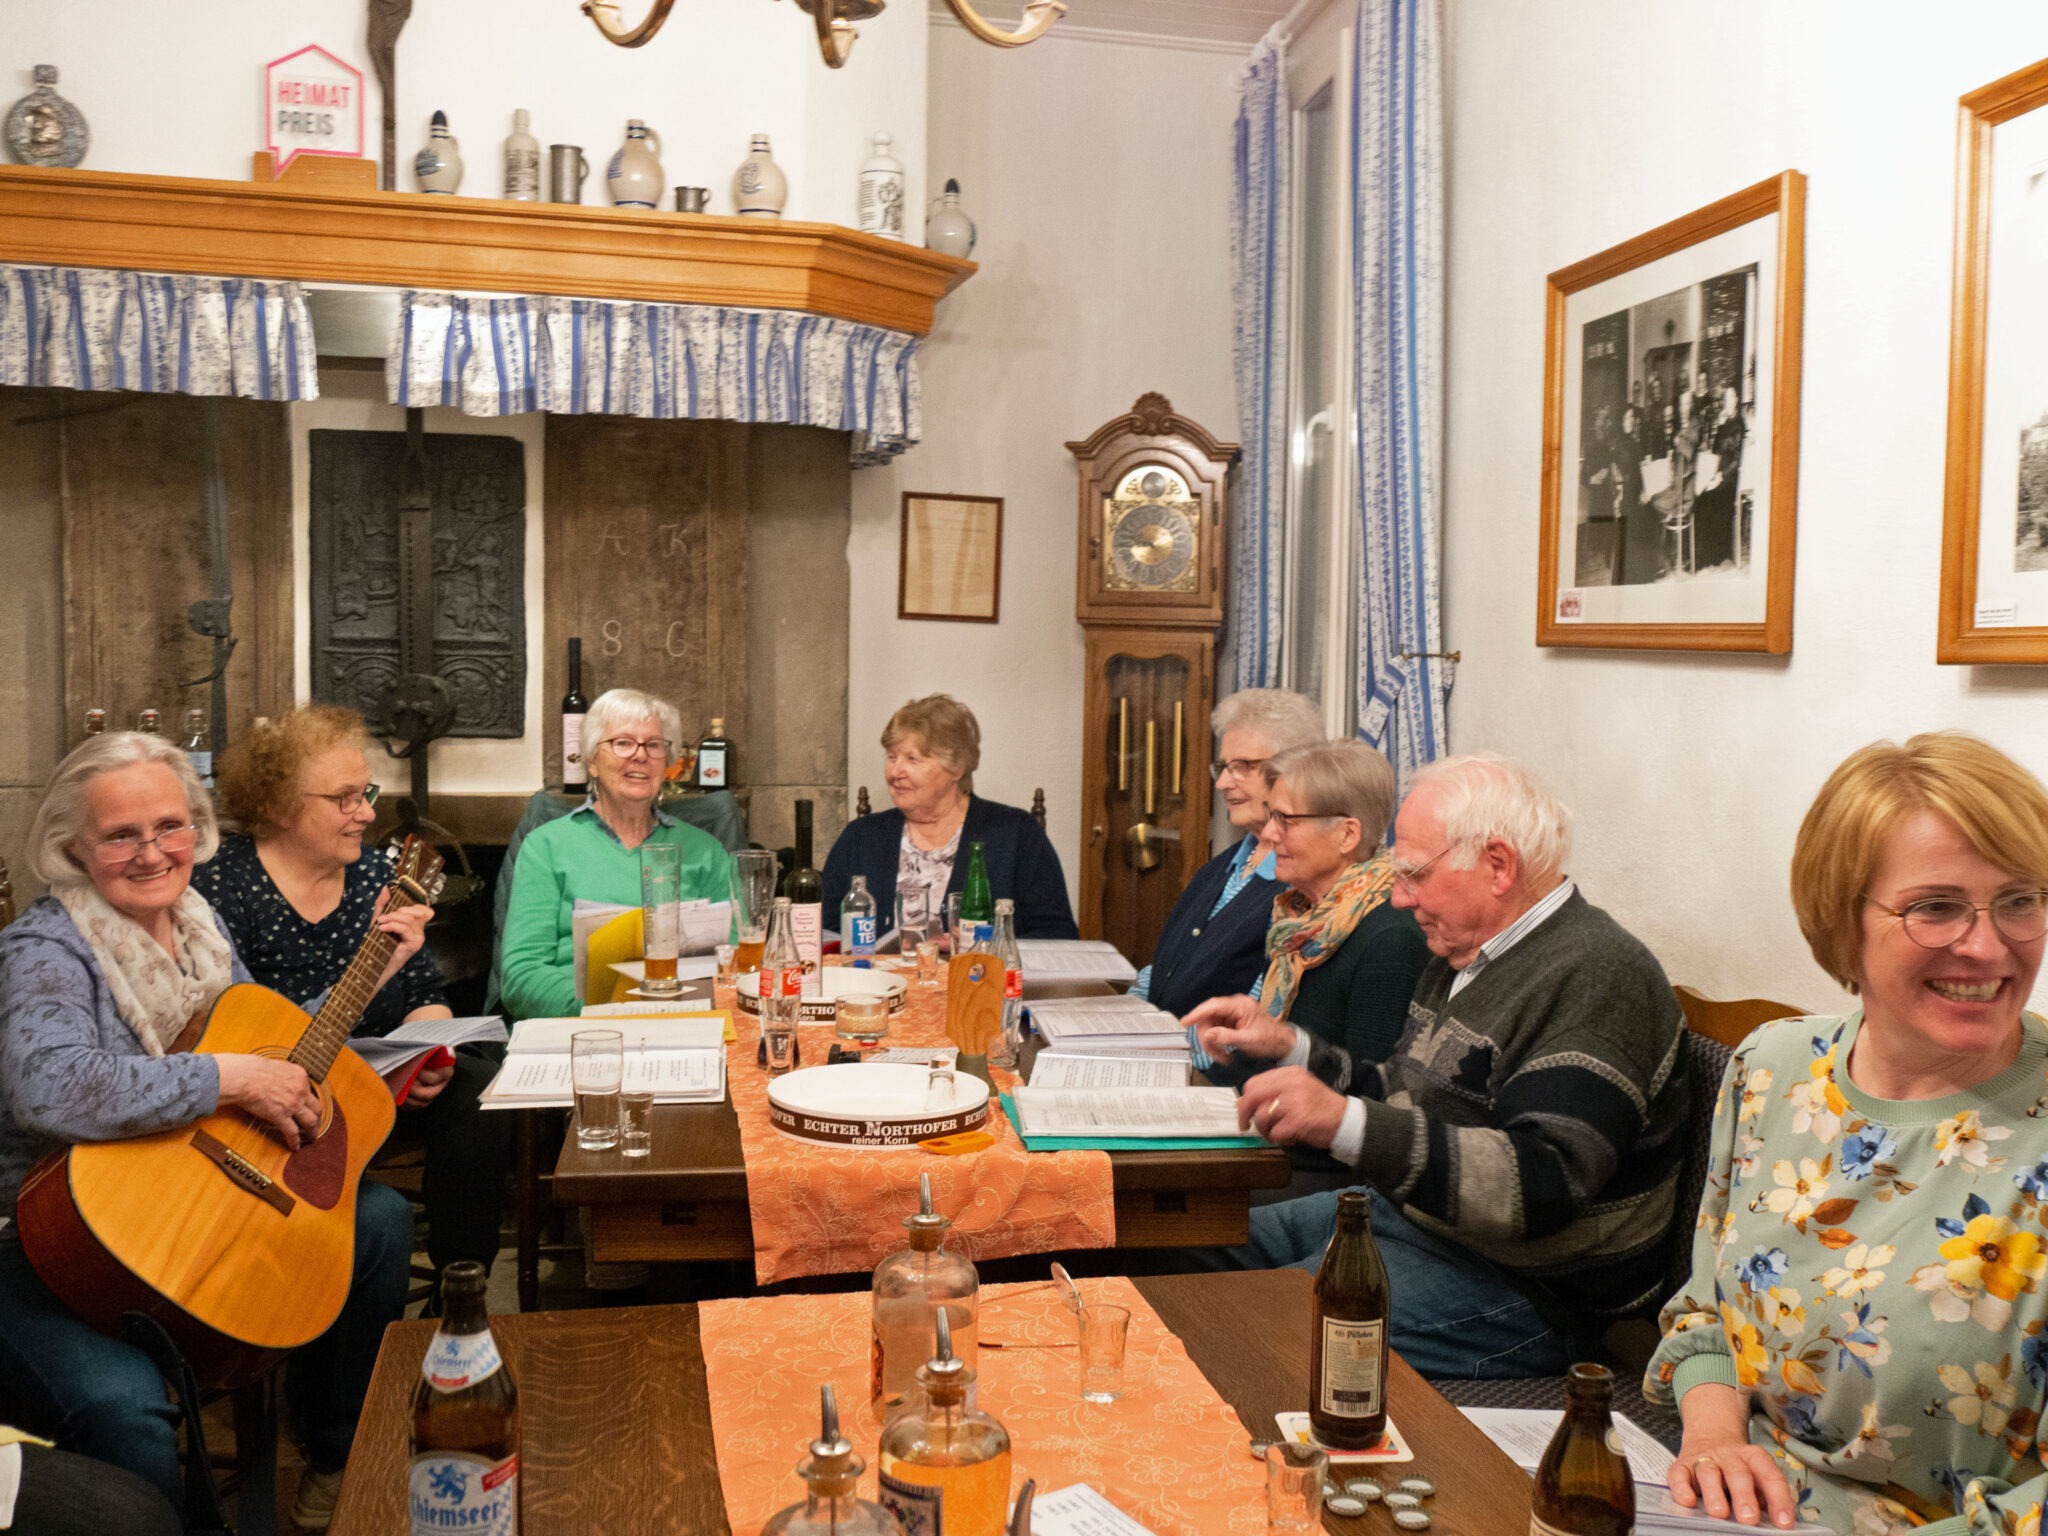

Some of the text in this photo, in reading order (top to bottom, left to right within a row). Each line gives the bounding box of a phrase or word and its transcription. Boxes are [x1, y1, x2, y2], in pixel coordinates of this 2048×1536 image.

[278, 81, 350, 108] HEIMAT
[278, 110, 334, 135] PREIS
[803, 1118, 860, 1136] ECHTER
[865, 1119, 958, 1137] NORTHOFER
[851, 1136, 909, 1145] reiner Korn
